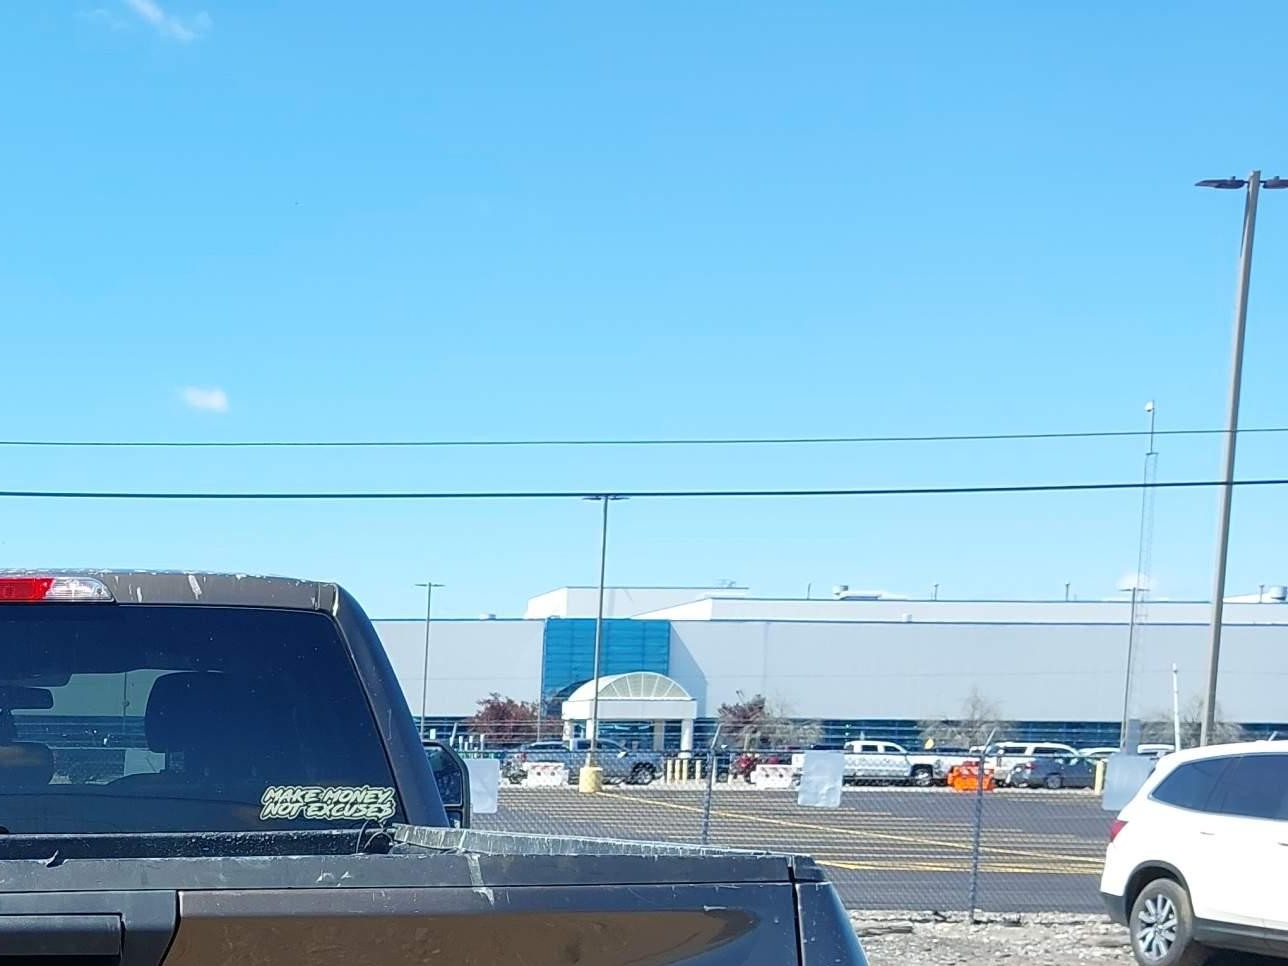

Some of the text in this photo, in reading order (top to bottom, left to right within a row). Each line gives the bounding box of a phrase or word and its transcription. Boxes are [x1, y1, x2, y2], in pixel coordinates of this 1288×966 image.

[264, 787, 393, 804] MAKE MONEY
[263, 802, 303, 818] NOT
